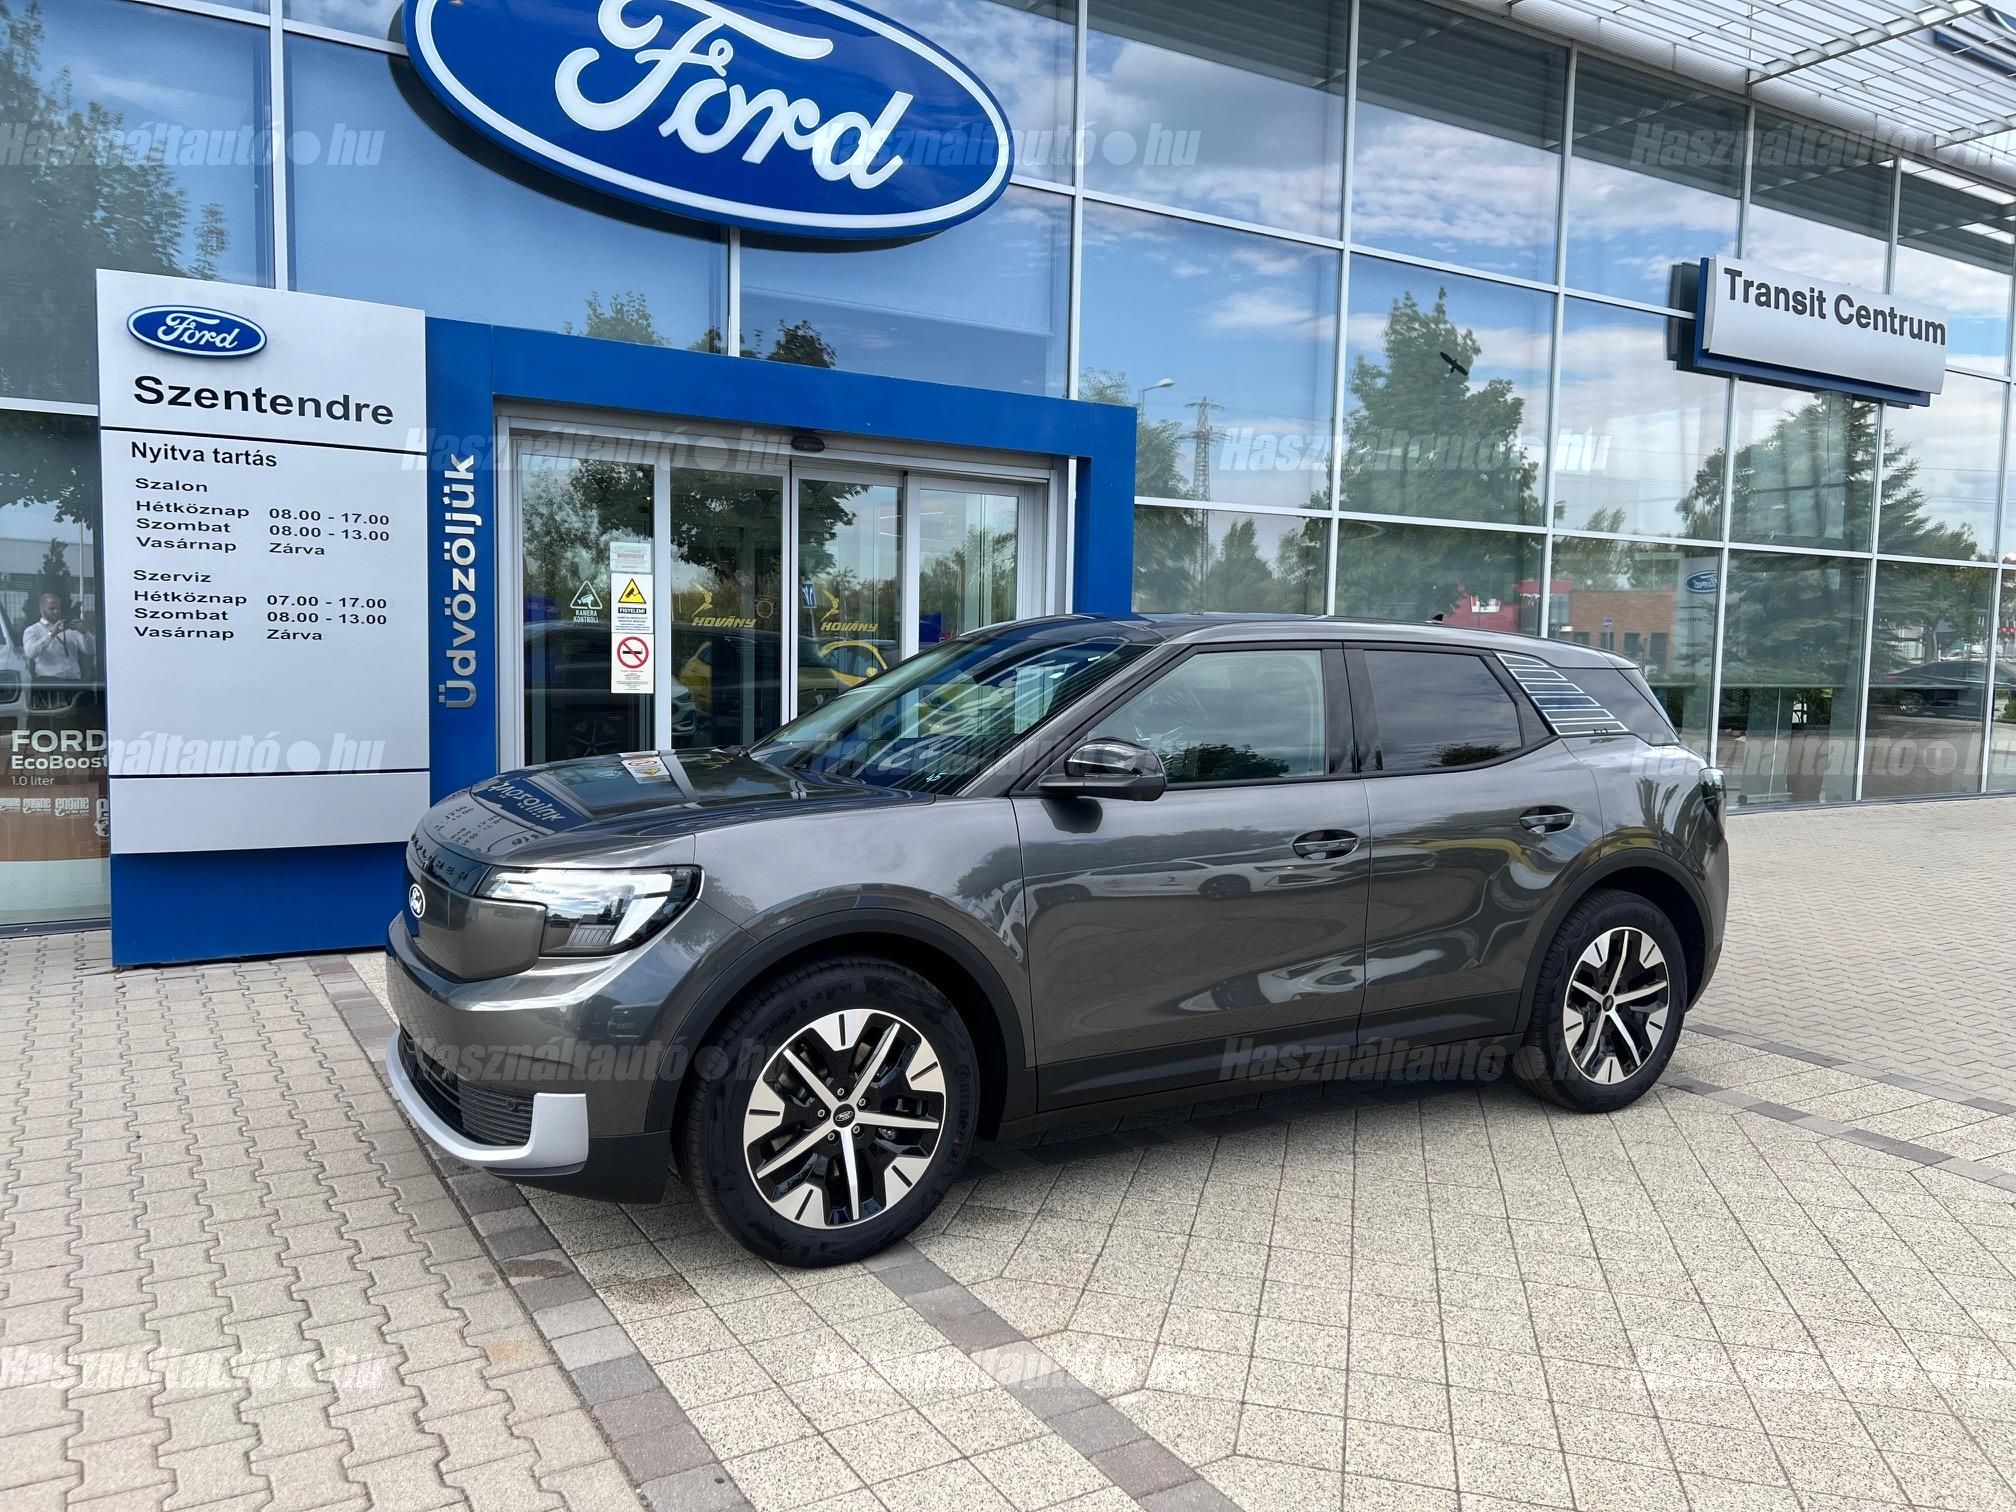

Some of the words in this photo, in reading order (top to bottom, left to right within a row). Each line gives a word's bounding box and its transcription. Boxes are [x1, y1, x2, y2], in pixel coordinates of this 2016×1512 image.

[554, 0, 913, 190] Ford
[1723, 267, 1827, 320] Transit
[1834, 293, 1946, 346] Centrum
[157, 312, 240, 349] Ford
[133, 375, 395, 425] Szentendre
[131, 440, 205, 464] Nyitva
[213, 447, 278, 467] tartás
[135, 477, 209, 493] Szalon
[136, 500, 250, 519] Hétköznap
[269, 508, 321, 521] 08.00
[341, 512, 390, 525] 17.00
[136, 517, 231, 533] Szombat
[269, 525, 321, 538] 08.00
[341, 528, 390, 541] 13.00
[136, 536, 237, 553] Vasárnap
[269, 542, 325, 555] Zárva
[133, 569, 212, 583] Szerviz
[438, 453, 483, 708] Üdvözöljük
[134, 590, 247, 607] Hétköznap
[266, 594, 319, 606] 07.00
[338, 597, 387, 609] 17.00
[134, 608, 229, 621] Szombat
[266, 611, 319, 623] 08.00
[338, 613, 387, 625] 13.00
[573, 616, 600, 624] KONTROLL
[575, 609, 597, 617] KAMERA
[692, 615, 757, 628] HOVÁNY
[134, 626, 235, 641] Vasárnap
[266, 629, 323, 640] Zárva
[820, 621, 879, 632] HOVÁNY
[11, 729, 108, 752] FORD
[11, 755, 108, 770] EcoBoost
[11, 776, 28, 786] 1.0
[30, 775, 55, 786] liter
